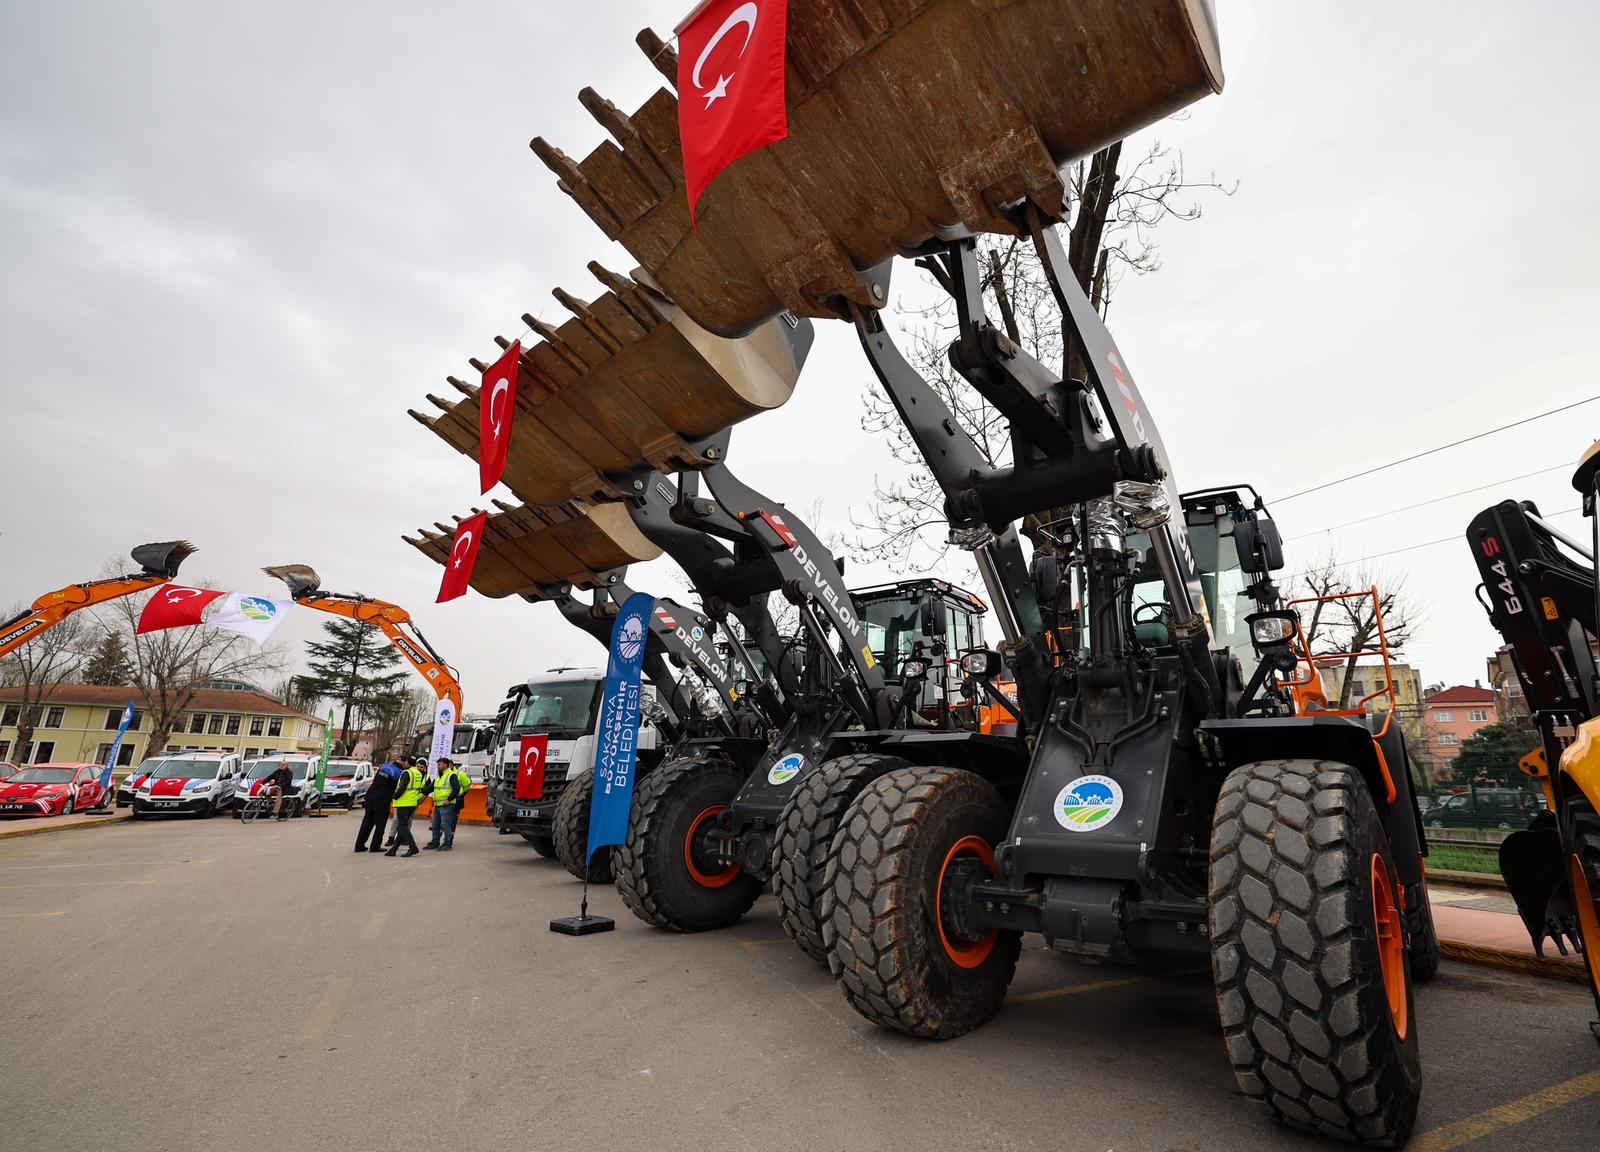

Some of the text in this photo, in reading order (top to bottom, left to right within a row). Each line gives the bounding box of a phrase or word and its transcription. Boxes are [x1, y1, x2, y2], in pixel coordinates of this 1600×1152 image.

[793, 545, 860, 637] DEVELON
[398, 640, 423, 663] DEVELON
[675, 626, 728, 684] DEVELON
[600, 695, 617, 778] SAKARYA
[605, 680, 628, 795] BÜYÜKŞEHİR
[615, 684, 638, 787] BELEDİYESİ
